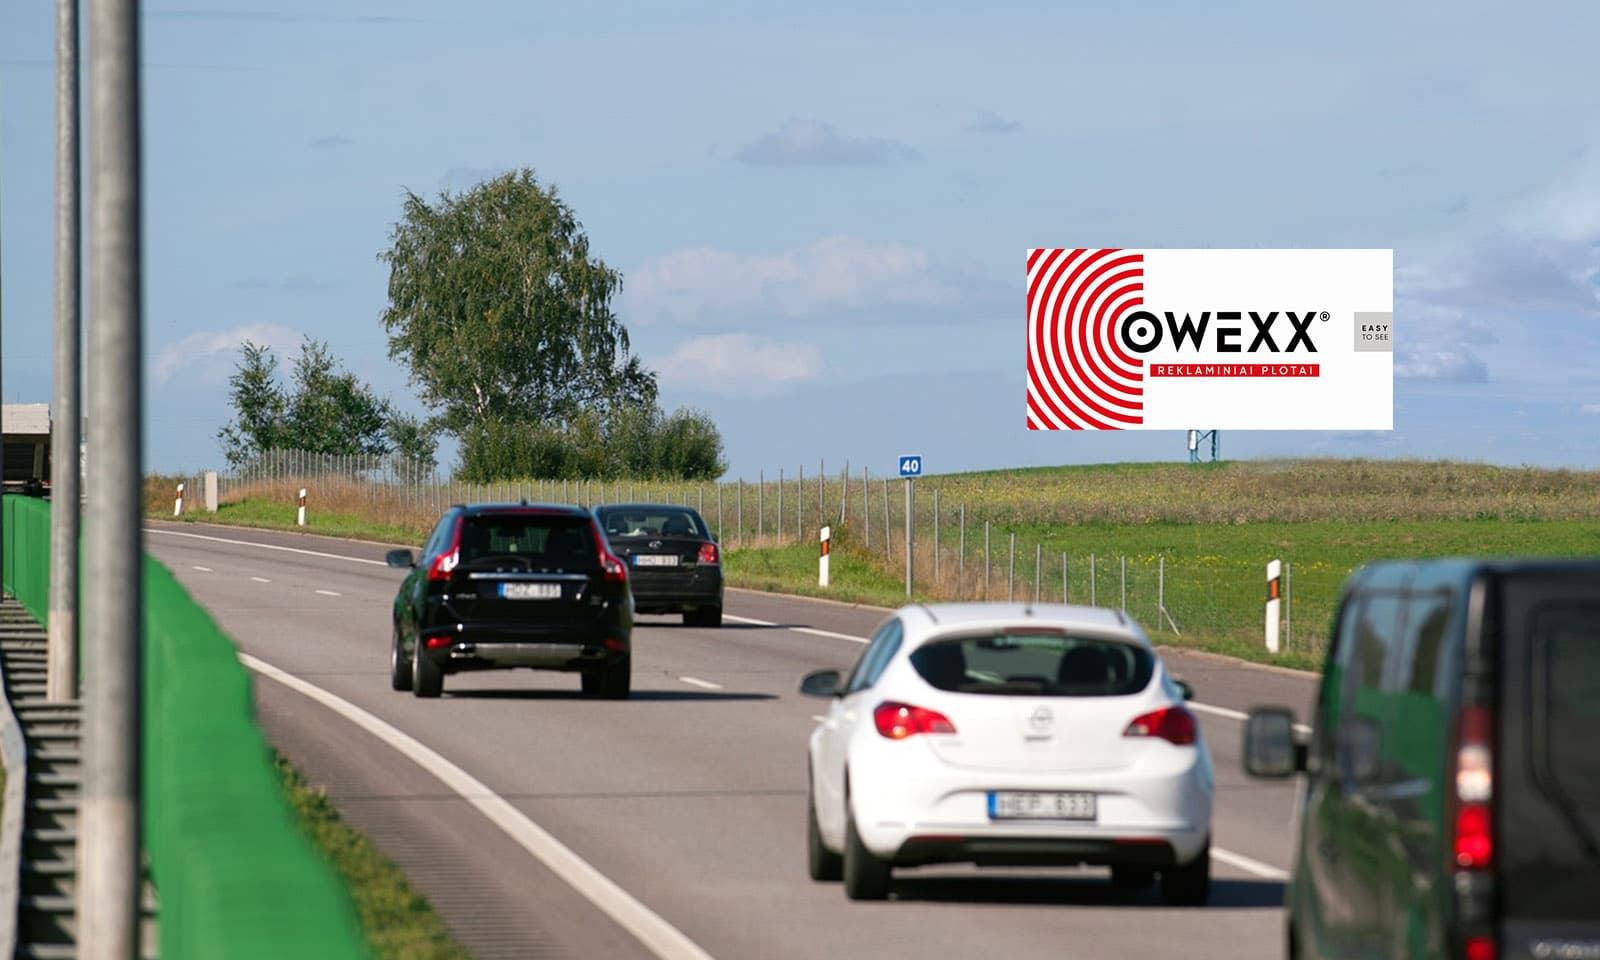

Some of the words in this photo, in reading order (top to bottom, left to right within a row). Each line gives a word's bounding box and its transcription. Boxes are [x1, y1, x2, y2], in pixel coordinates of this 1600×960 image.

[1361, 324, 1388, 332] EASY
[1362, 333, 1373, 341] TO
[1374, 333, 1389, 341] SEE
[1157, 365, 1254, 376] REKLAMINIAI
[1261, 365, 1313, 376] PLOTAI
[902, 459, 919, 473] 40
